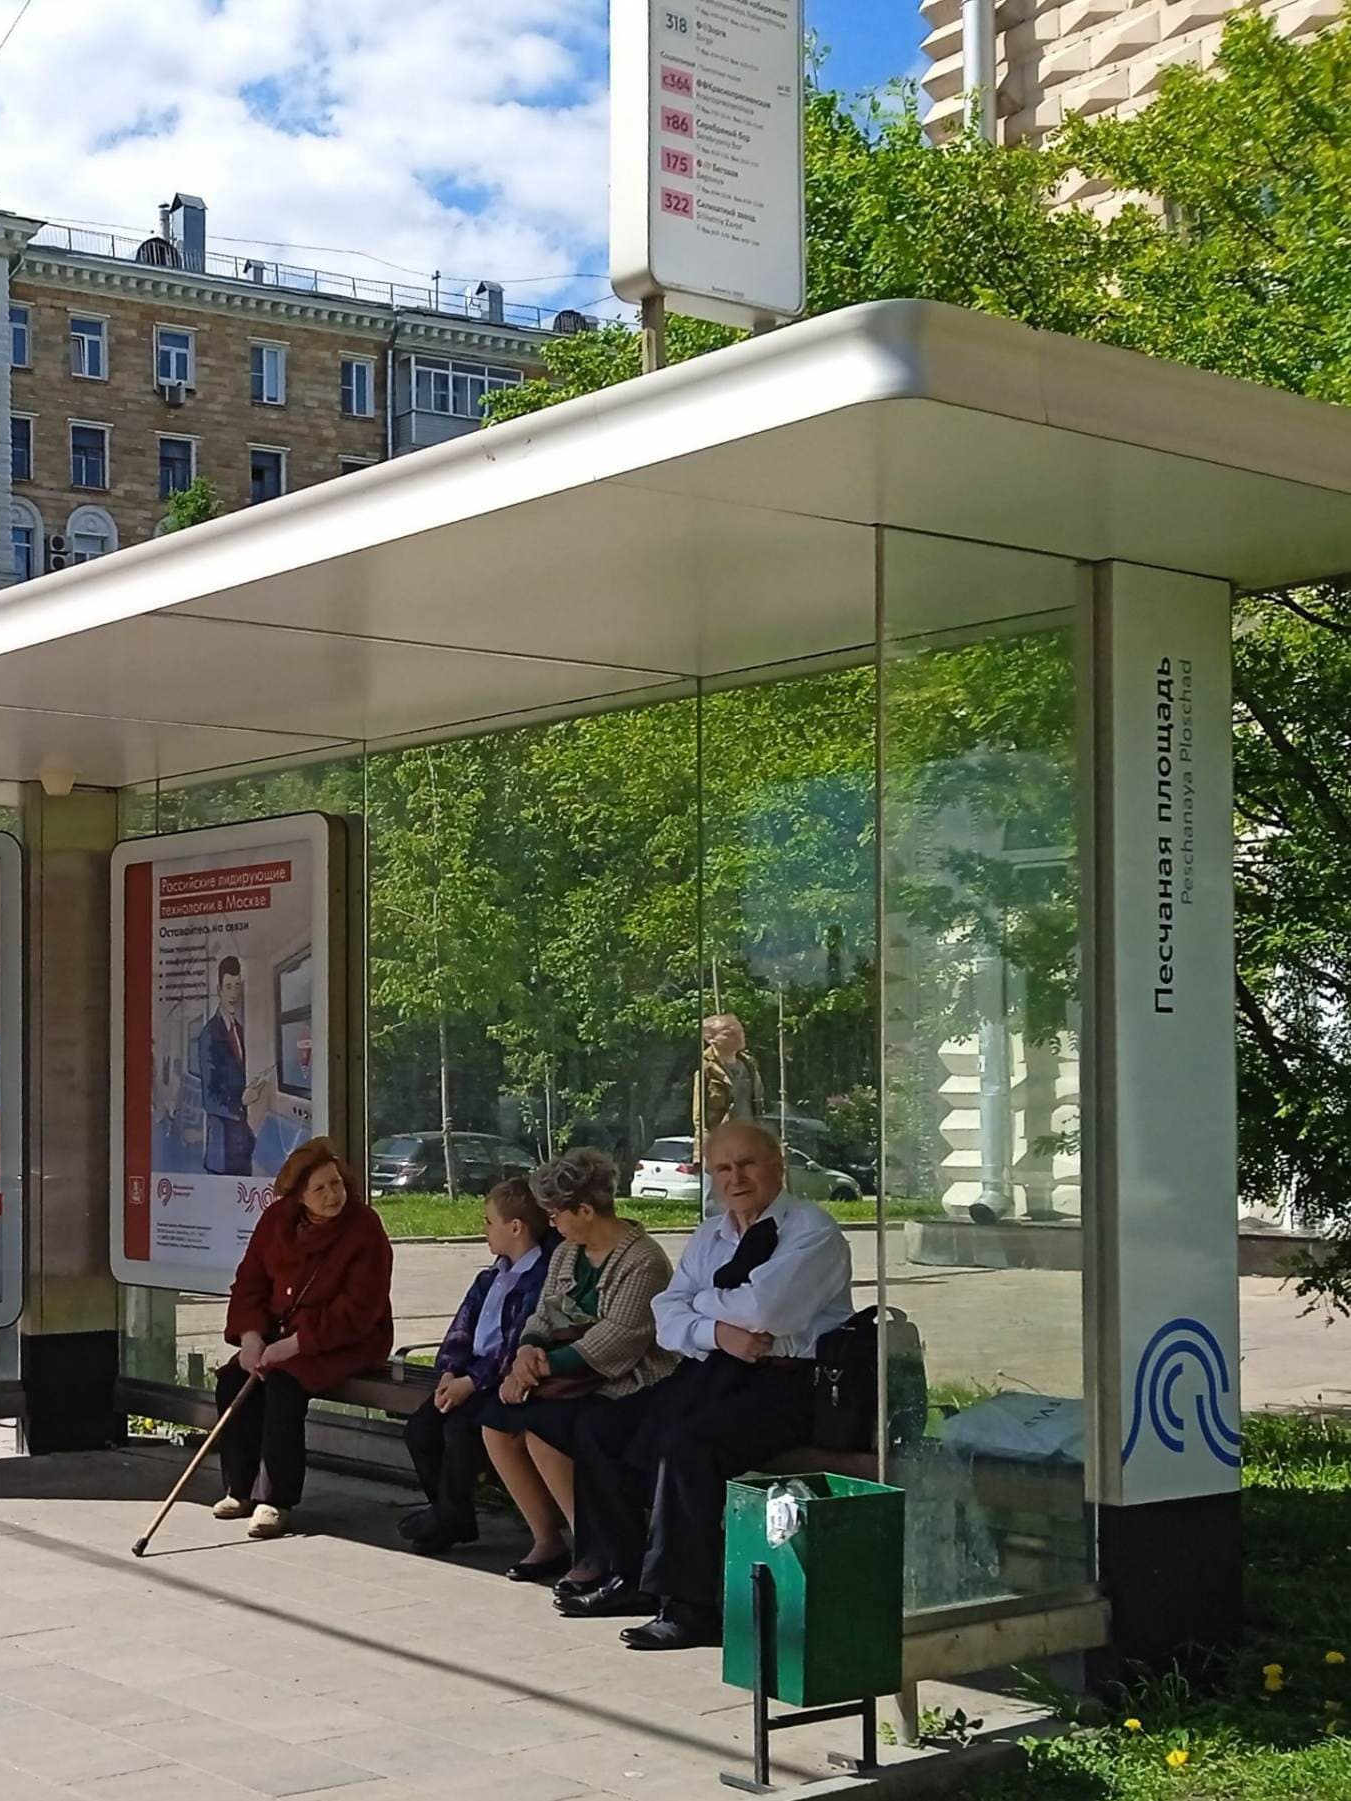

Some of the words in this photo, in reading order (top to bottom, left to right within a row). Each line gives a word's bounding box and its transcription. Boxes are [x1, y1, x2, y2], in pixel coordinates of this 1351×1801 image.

[665, 12, 687, 33] 318
[666, 152, 688, 173] 175
[664, 193, 690, 213] 322
[1178, 659, 1193, 763] Ploschad
[1156, 656, 1174, 823] площадь
[1180, 771, 1195, 905] Peschanaya
[161, 876, 215, 893] Российские
[218, 868, 286, 887] лидирующие
[161, 901, 215, 916] технологии
[217, 901, 223, 909] в
[225, 895, 267, 909] Москве
[1154, 836, 1174, 1014] Песчаная
